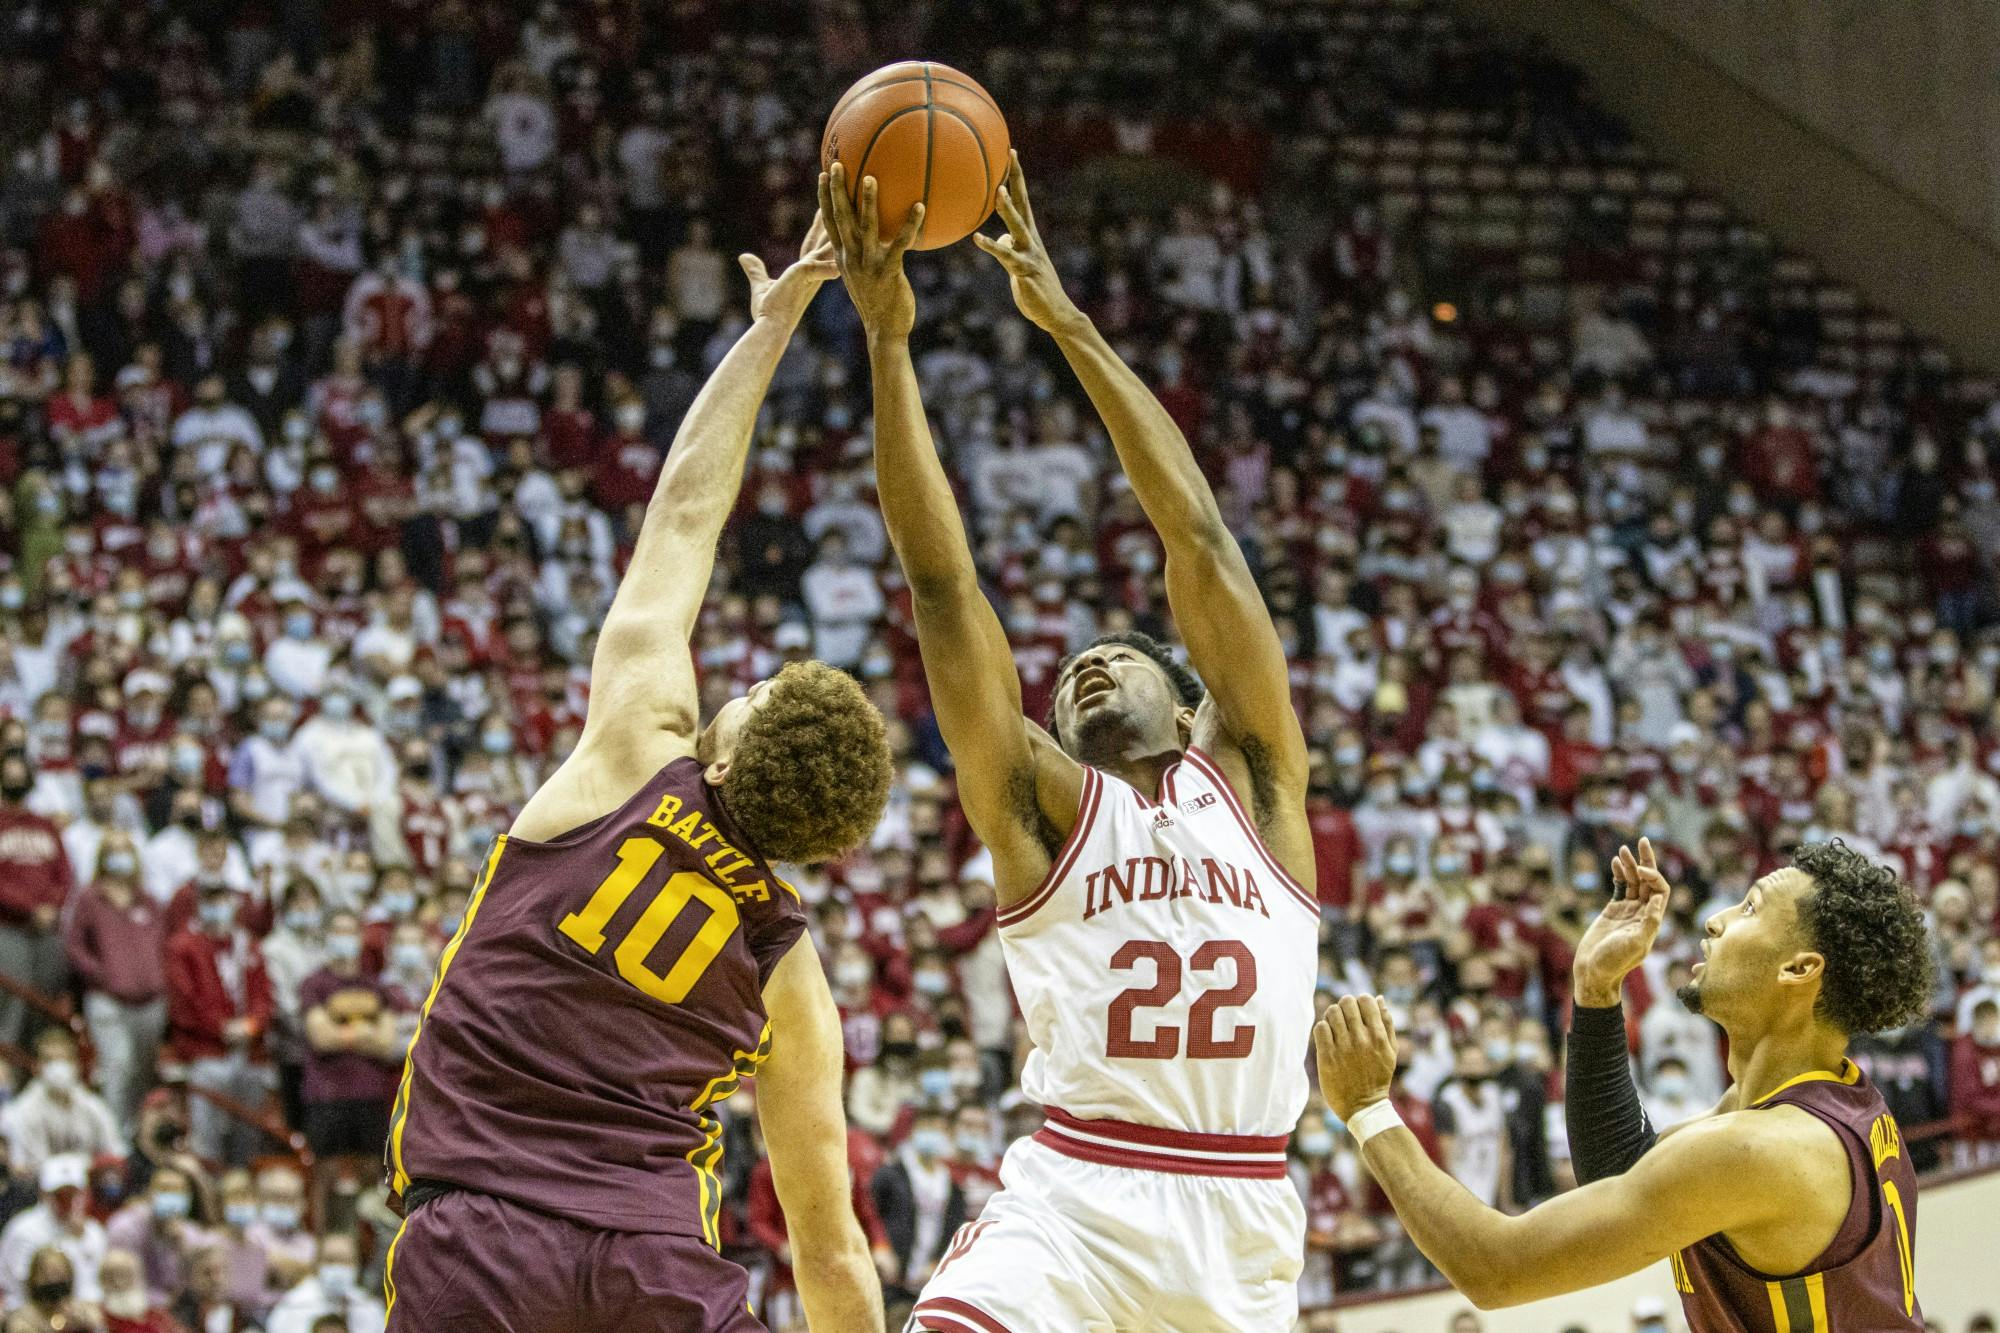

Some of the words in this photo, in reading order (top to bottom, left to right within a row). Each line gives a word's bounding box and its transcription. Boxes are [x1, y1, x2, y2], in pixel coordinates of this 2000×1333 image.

[647, 794, 771, 905] BATTLE
[1083, 854, 1271, 921] INDIANA
[557, 837, 741, 1005] 10
[1105, 939, 1258, 1060] 22
